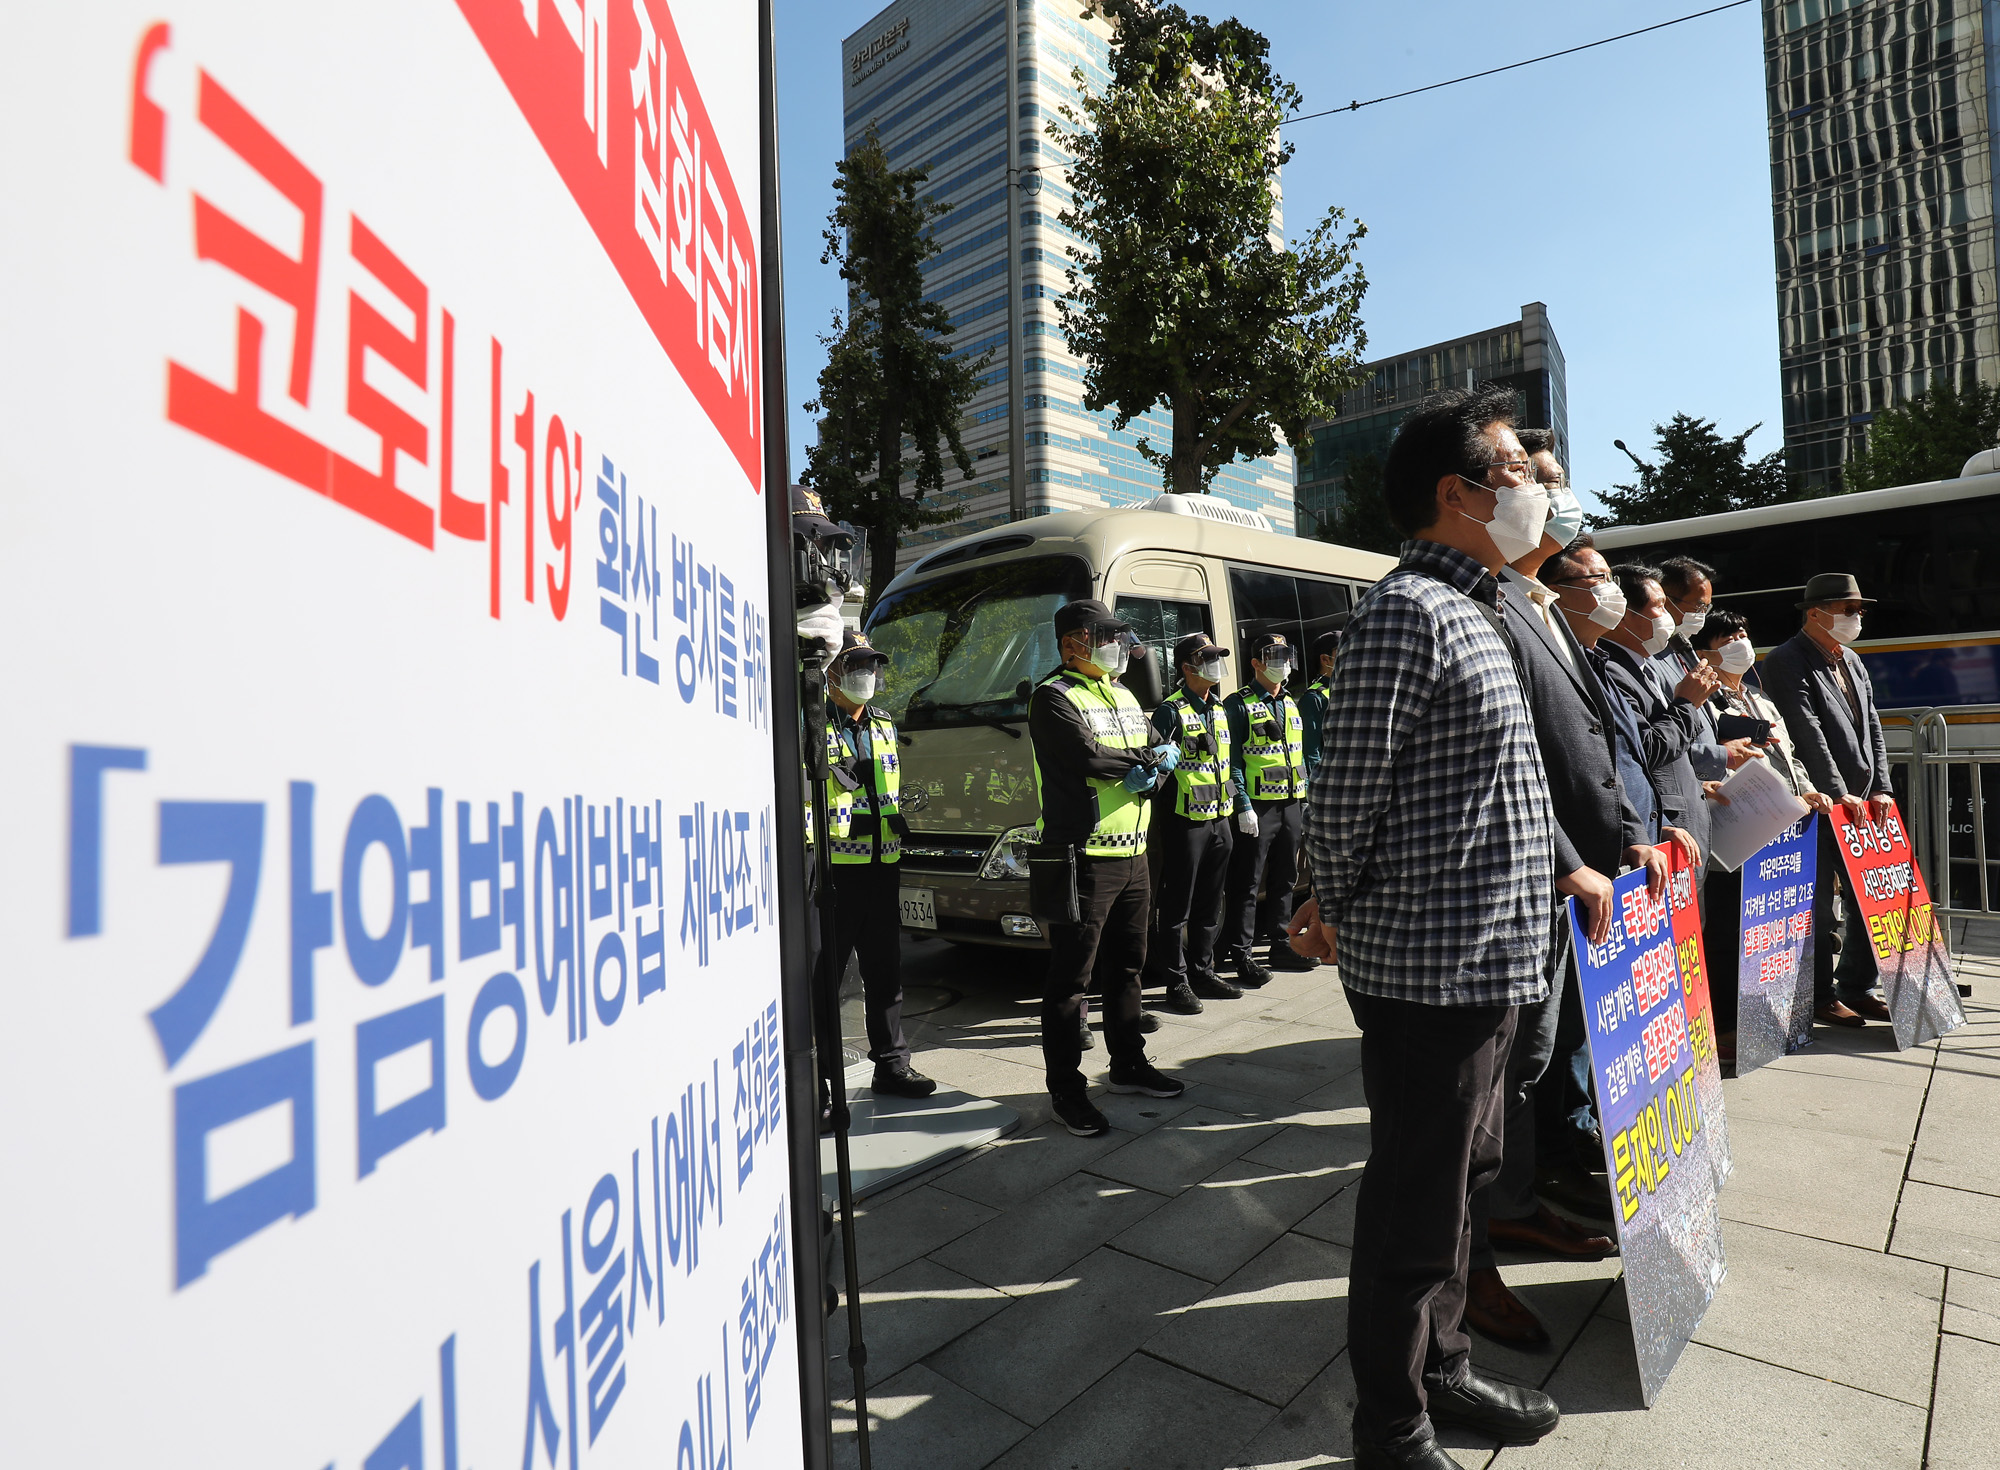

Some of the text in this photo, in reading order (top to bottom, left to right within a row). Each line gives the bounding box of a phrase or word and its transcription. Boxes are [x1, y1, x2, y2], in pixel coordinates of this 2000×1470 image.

[851, 17, 909, 73] 감리교본부
[852, 40, 909, 87] Methodist Center
[630, 0, 755, 440] 집회금지
[596, 453, 660, 685] 확산
[671, 532, 738, 719] 방지를
[743, 599, 768, 735] 위해
[1759, 851, 1802, 881] 자유민주주의를
[1861, 860, 1919, 902] 서민경제파탄
[1744, 882, 1814, 919] 지켜낼 수단 헌법 21조
[1744, 909, 1812, 958] 집회결사의 자유를
[1868, 903, 1938, 959] 문재인 OUT
[1596, 937, 1679, 1036] 사법개혁 법원장악
[1675, 931, 1702, 996] 방역
[1759, 946, 1796, 984] 보장하라!
[1605, 998, 1688, 1106] 검찰개혁 검찰장악
[1612, 1065, 1700, 1225] 문재인 OUT
[522, 998, 781, 1470] 서울시에서 집회를
[739, 1193, 789, 1444] 협조해
